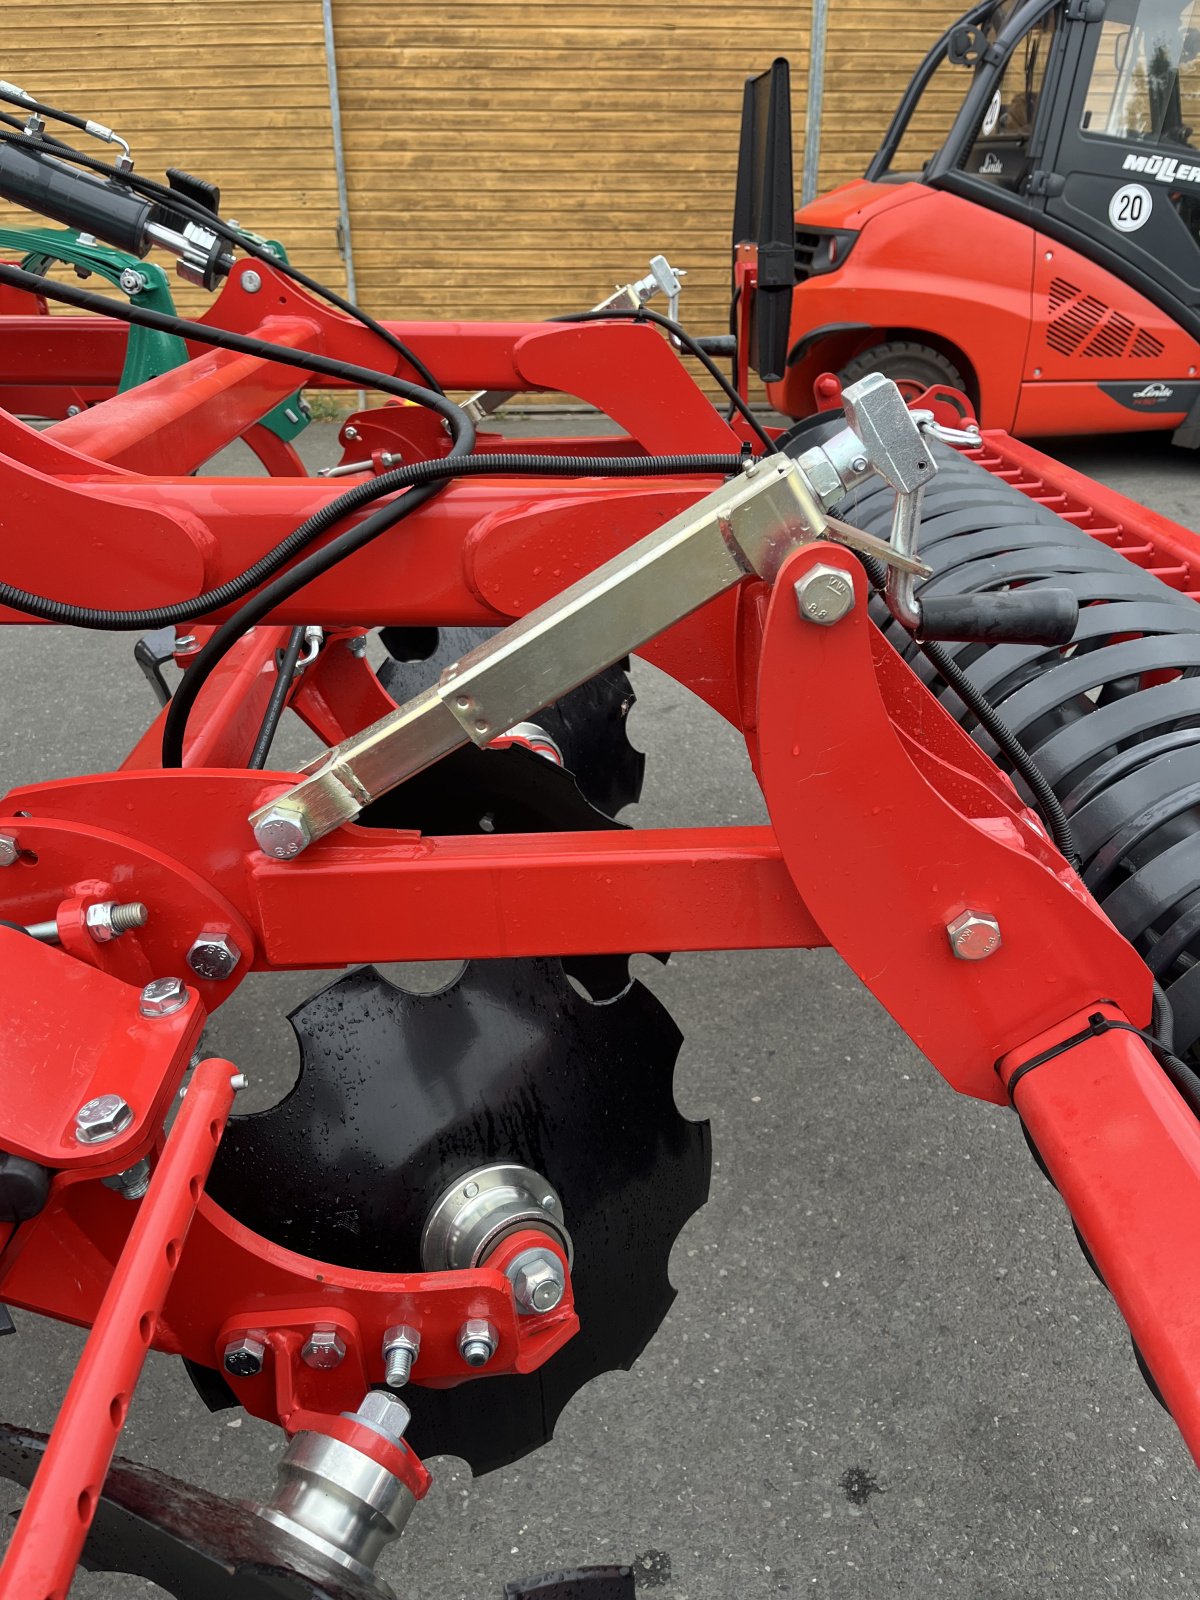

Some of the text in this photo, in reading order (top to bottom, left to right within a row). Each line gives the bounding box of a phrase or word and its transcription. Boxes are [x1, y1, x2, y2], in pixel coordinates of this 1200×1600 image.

[1122, 154, 1200, 183] MÜLLER
[1118, 195, 1143, 221] 20
[1133, 382, 1173, 398] Linde
[808, 602, 828, 619] 8.8
[274, 842, 299, 857] 8.8
